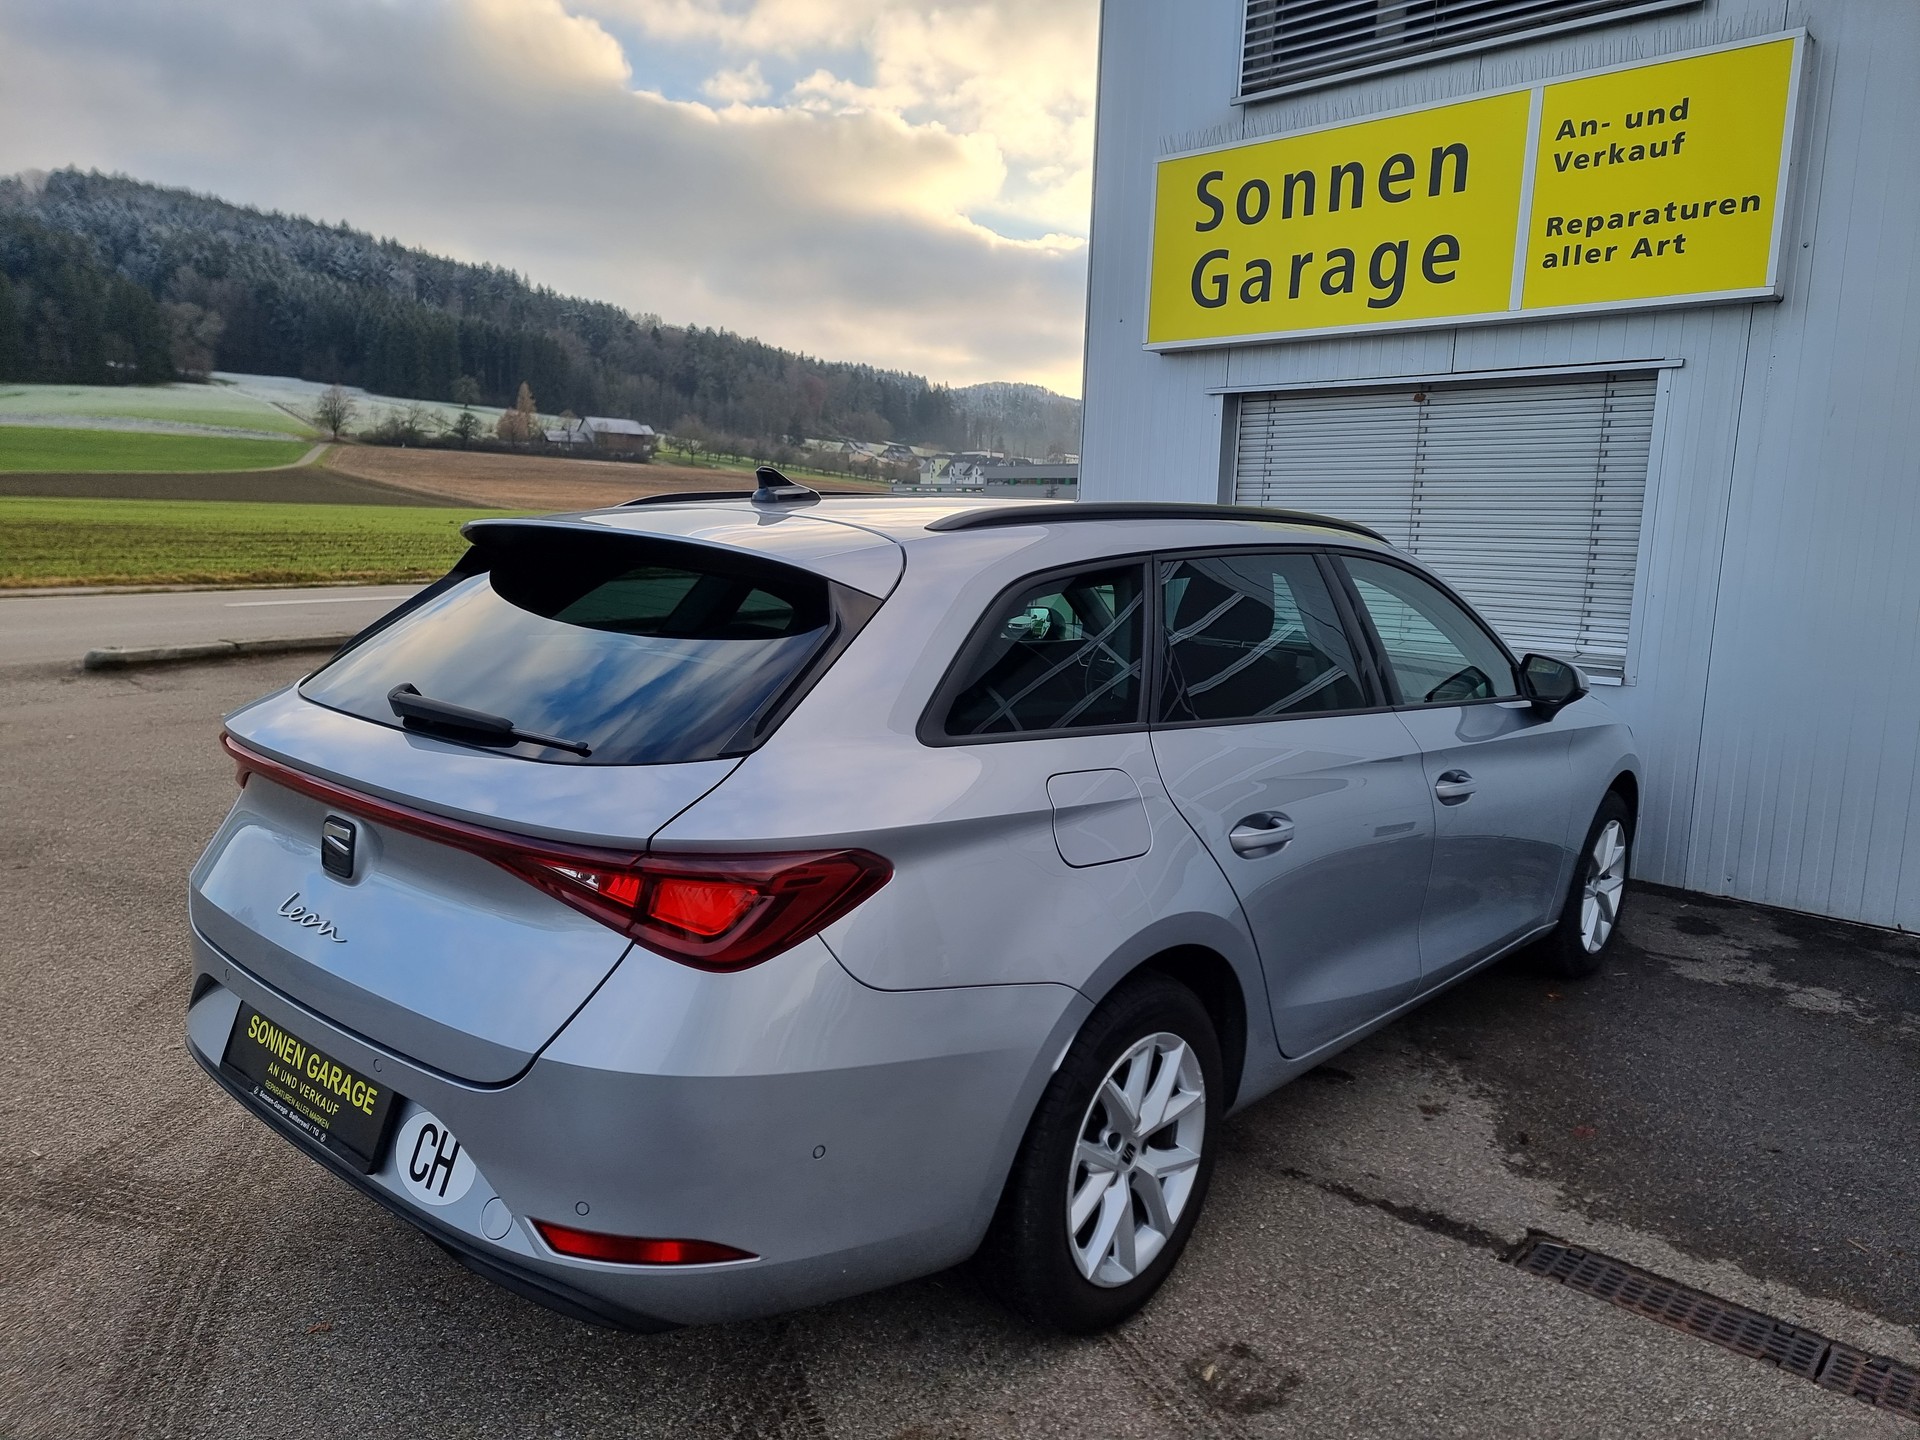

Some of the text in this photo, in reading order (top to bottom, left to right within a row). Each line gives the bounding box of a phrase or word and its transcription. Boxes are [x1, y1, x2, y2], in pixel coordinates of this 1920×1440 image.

[1554, 97, 1690, 142] An- und
[1553, 130, 1687, 174] Verkauf
[1194, 142, 1470, 233] Sonnen
[1545, 193, 1762, 240] Reparaturen
[1190, 231, 1462, 310] Garage
[1541, 233, 1687, 270] aller Art
[247, 1014, 378, 1116] SONNEN GARAGE
[267, 1061, 340, 1117] AN UND VERKAUF
[264, 1079, 330, 1130] REPARATUREN ALLER MARKEN
[312, 1126, 320, 1137] TG
[409, 1123, 461, 1198] CH
